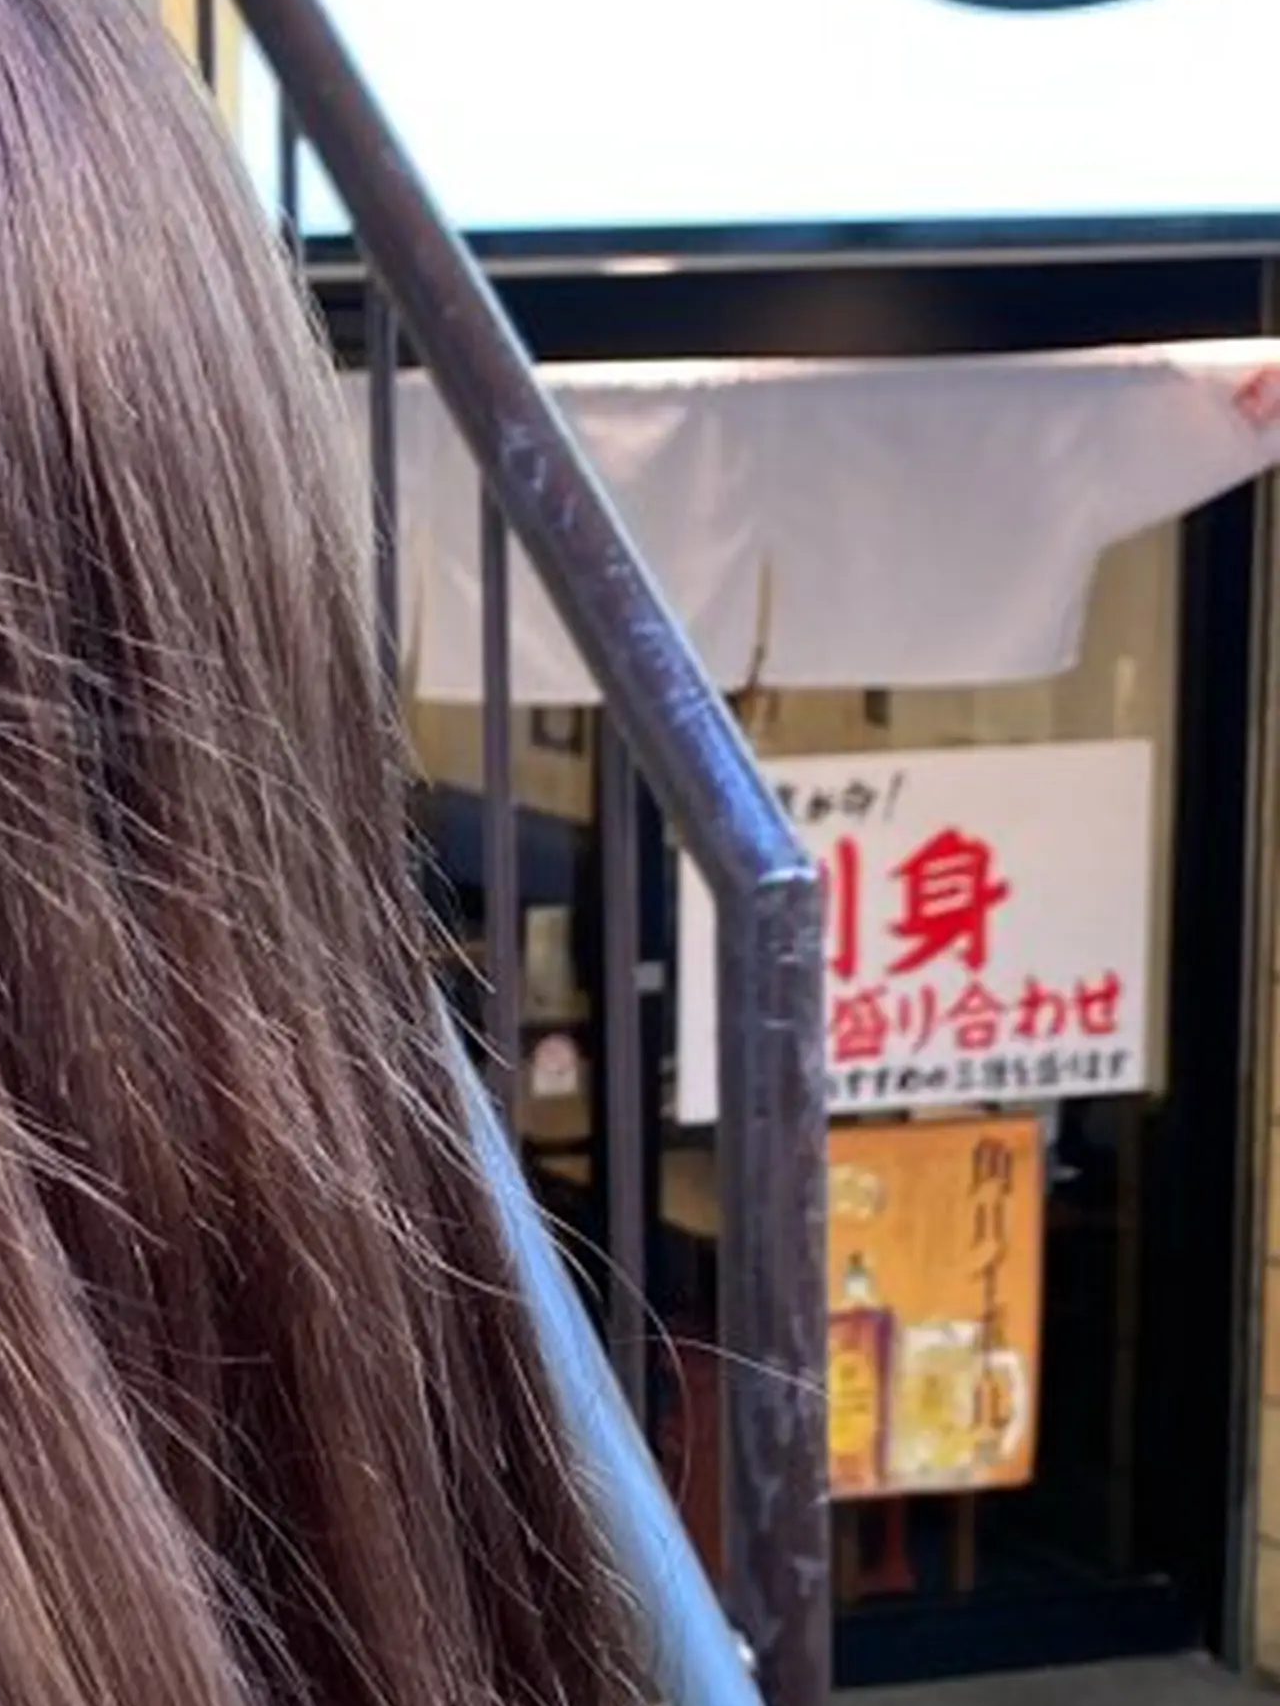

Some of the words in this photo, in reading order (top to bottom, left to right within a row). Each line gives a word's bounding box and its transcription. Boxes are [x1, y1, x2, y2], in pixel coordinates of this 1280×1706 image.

[830, 969, 1122, 1063] 盛り合わせ
